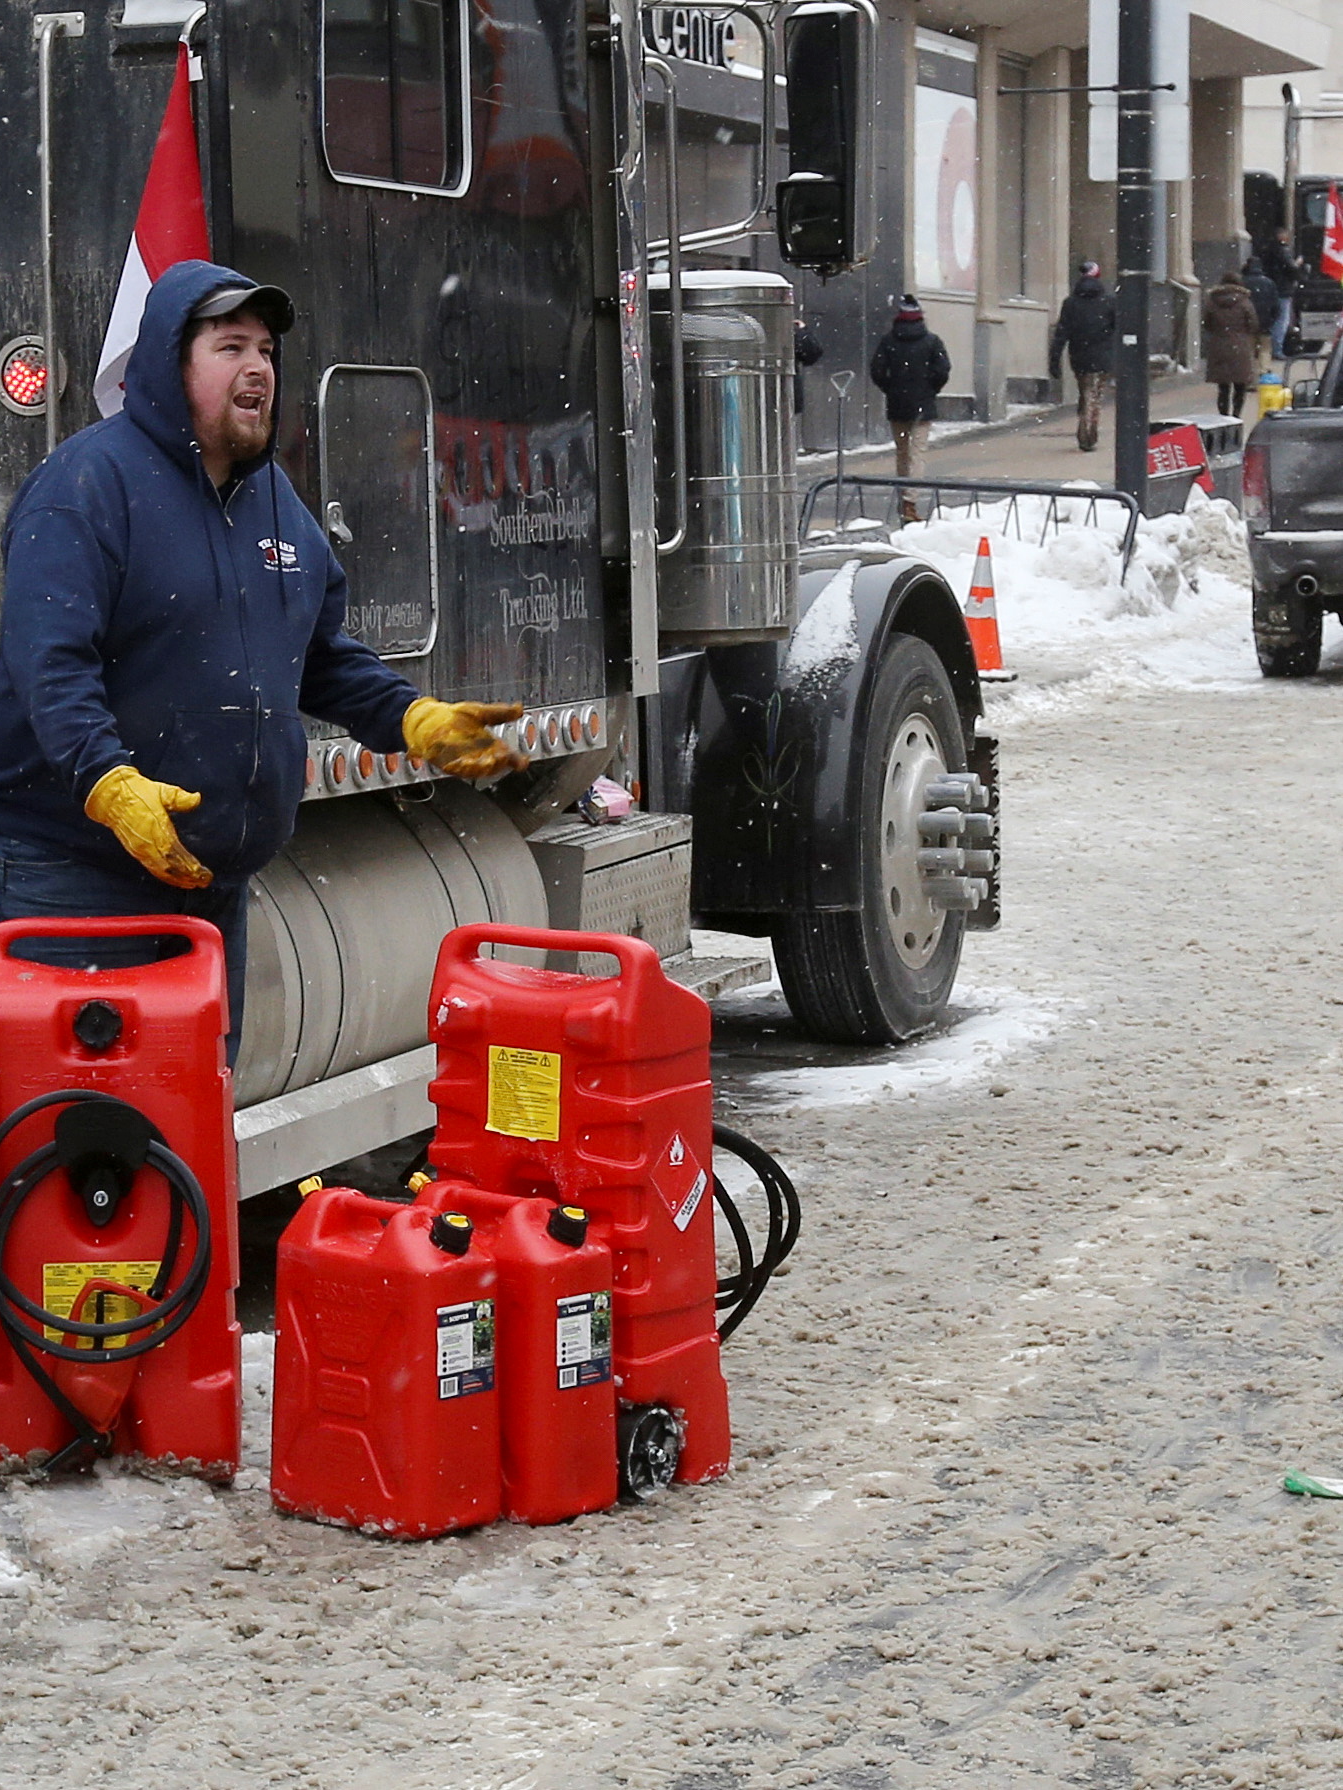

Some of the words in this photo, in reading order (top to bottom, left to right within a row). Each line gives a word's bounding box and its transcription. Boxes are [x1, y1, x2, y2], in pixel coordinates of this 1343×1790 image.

[651, 6, 736, 71] Centre
[490, 497, 555, 547] Southern
[556, 497, 589, 545] Belle
[361, 605, 383, 639] DOT
[499, 579, 559, 637] Trucking
